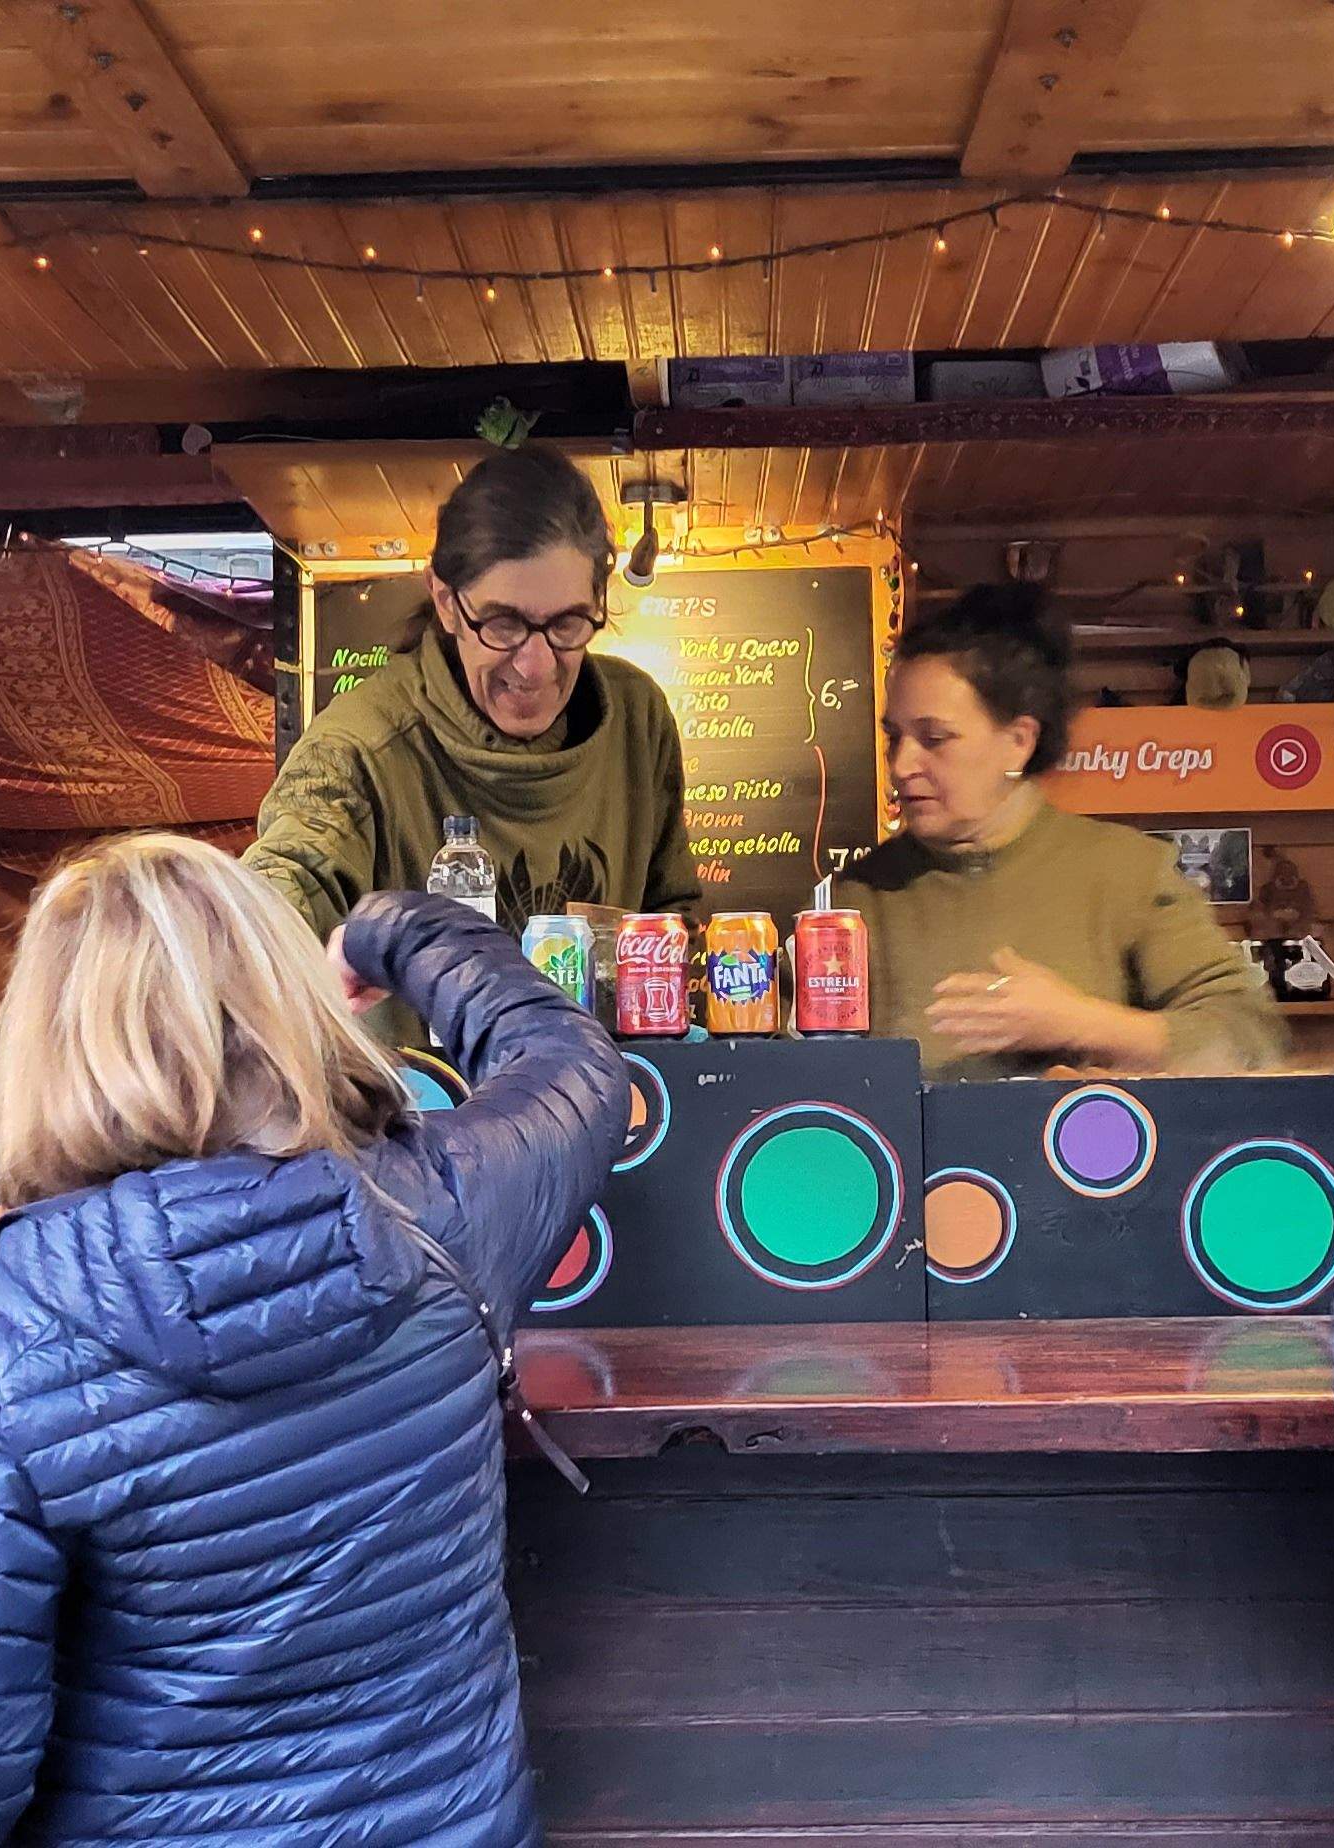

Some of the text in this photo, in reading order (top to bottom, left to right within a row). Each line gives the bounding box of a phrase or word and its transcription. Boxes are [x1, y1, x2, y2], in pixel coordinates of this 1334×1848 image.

[679, 637, 719, 660] York
[719, 641, 737, 664] y
[739, 637, 800, 661] Queso
[733, 663, 775, 686] York
[682, 691, 730, 713] Pisto
[682, 715, 755, 740] Cebolla
[1057, 741, 1213, 779] unky Creps
[683, 778, 783, 802] ueso Pisto
[688, 837, 731, 856] ueso
[616, 928, 689, 965] Coca-Col
[540, 969, 585, 985] STEA
[714, 962, 768, 989] FANTA
